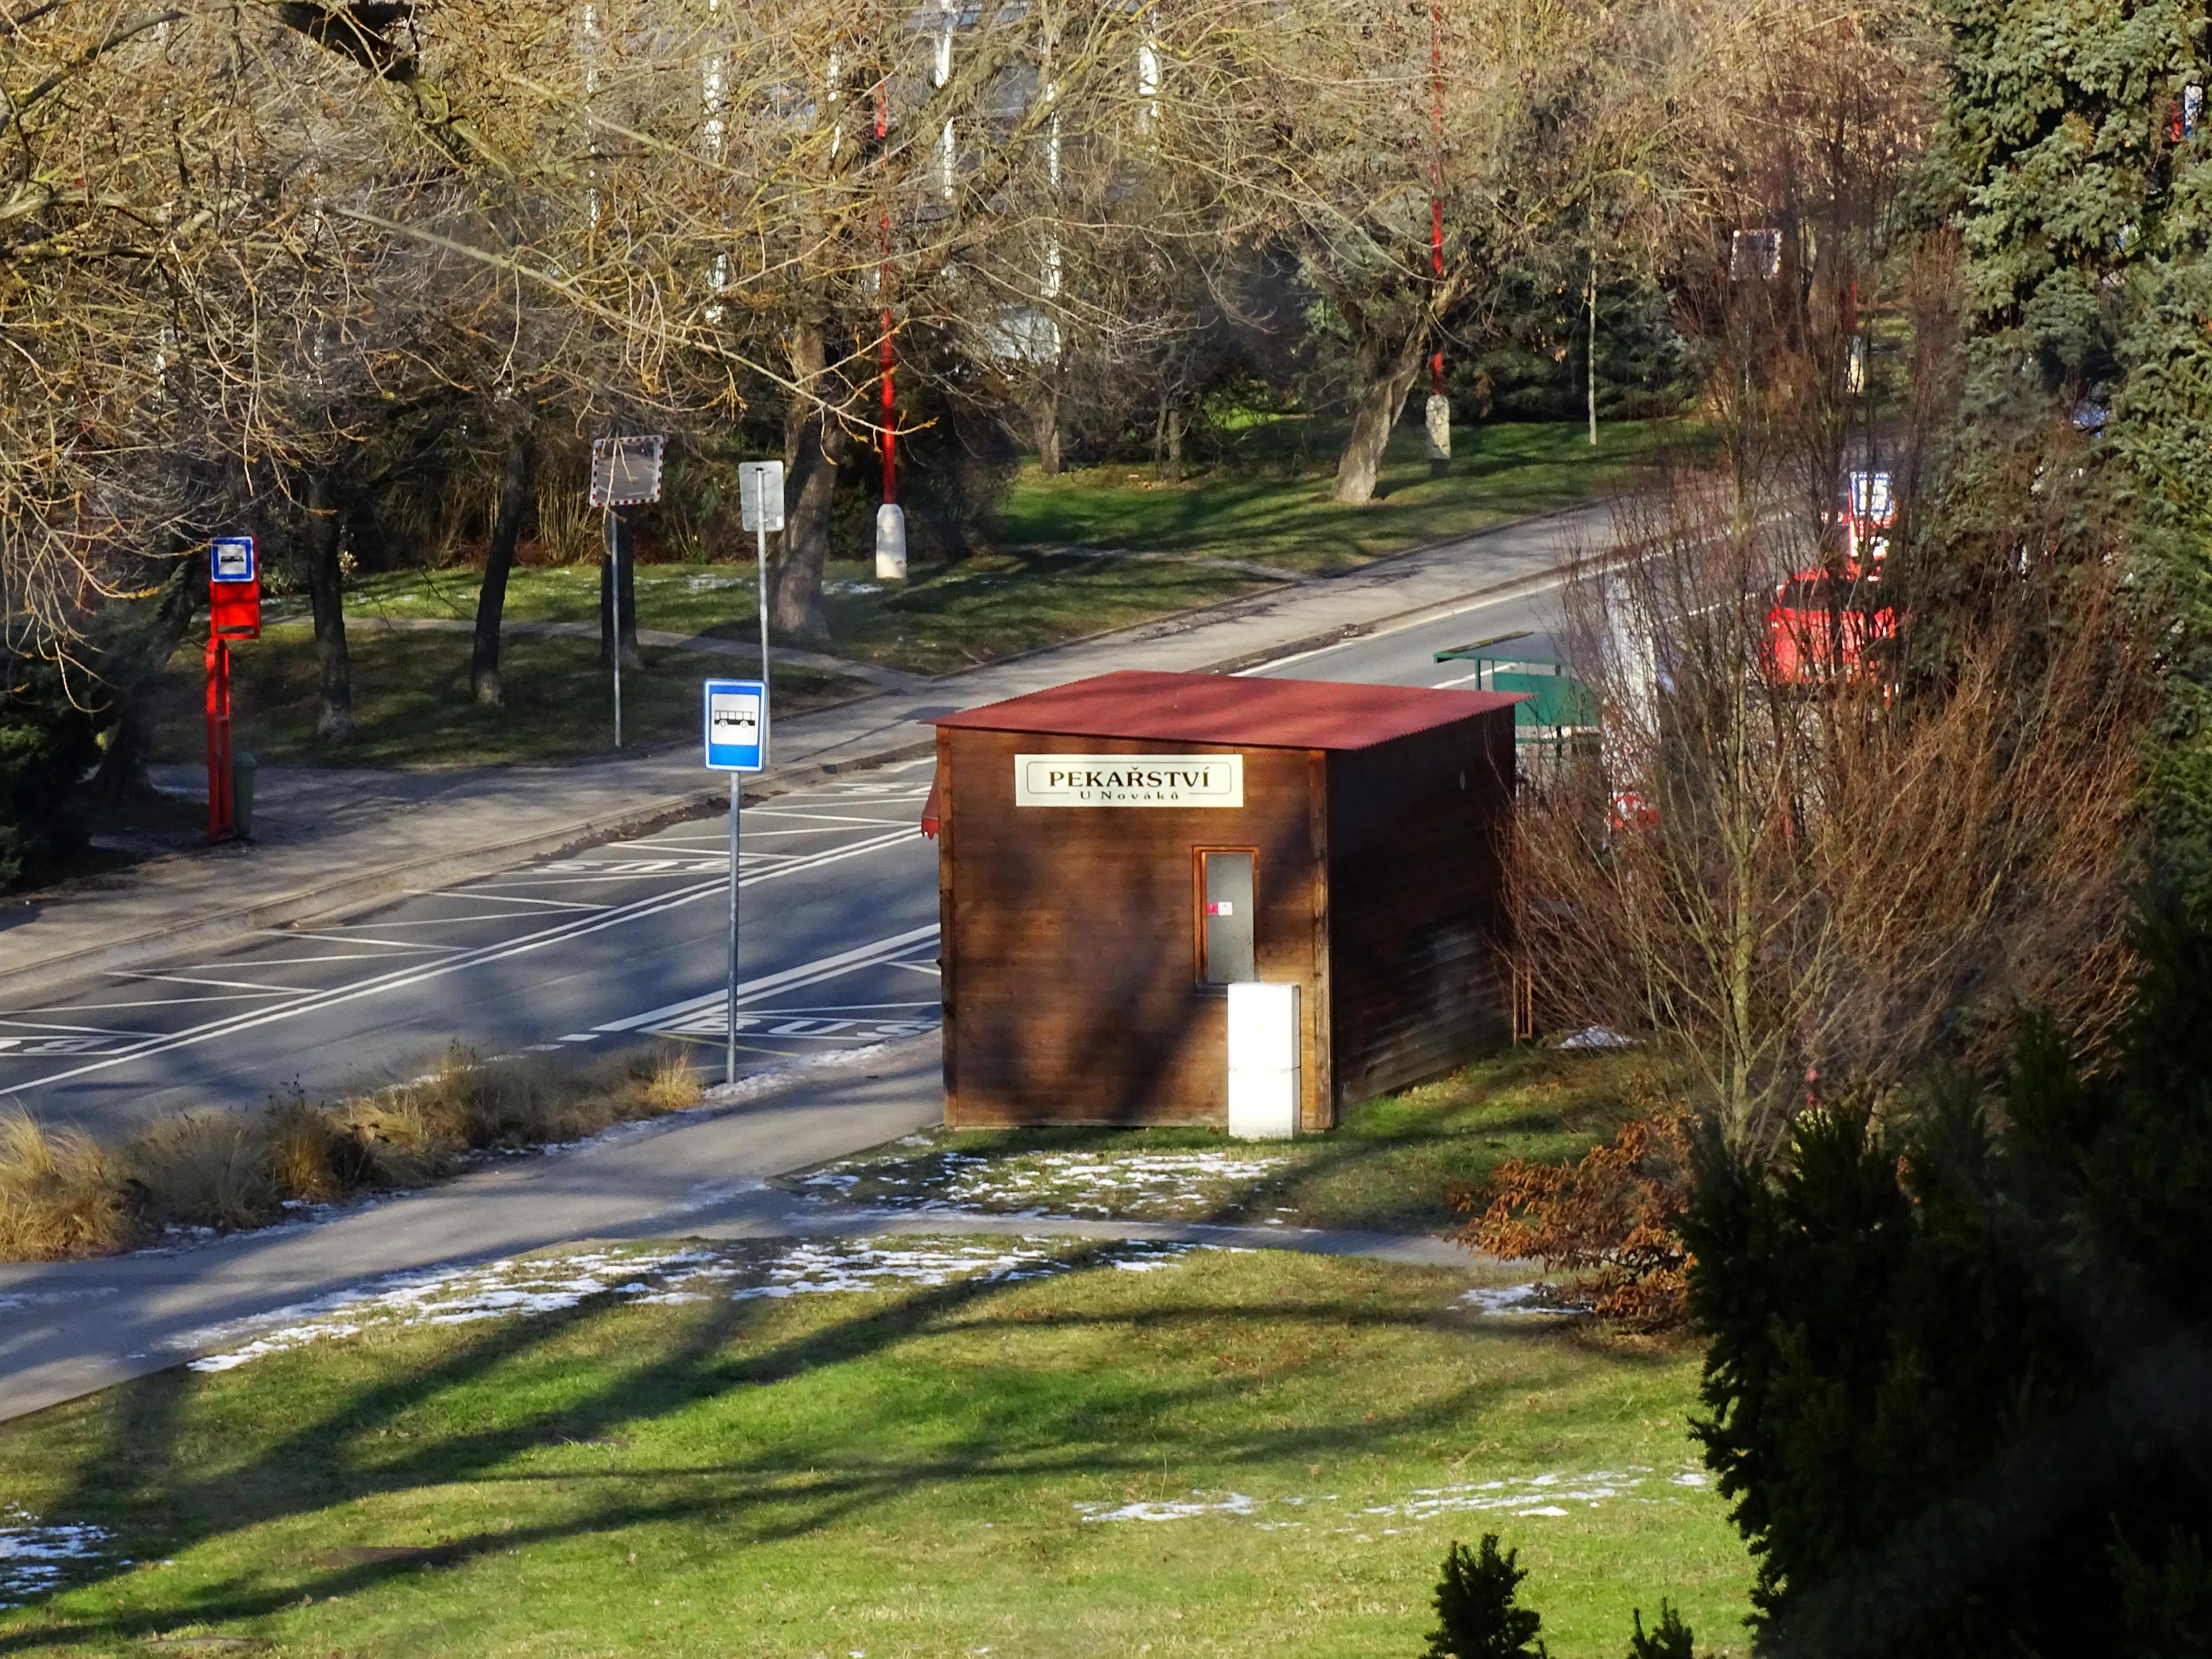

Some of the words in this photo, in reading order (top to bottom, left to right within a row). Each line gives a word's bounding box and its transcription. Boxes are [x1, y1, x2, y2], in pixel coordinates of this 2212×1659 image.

[1048, 766, 1211, 787] PEKAŘSTVÍ
[1080, 791, 1091, 800] U
[1101, 790, 1180, 800] Nováků
[673, 1015, 940, 1039] BUS
